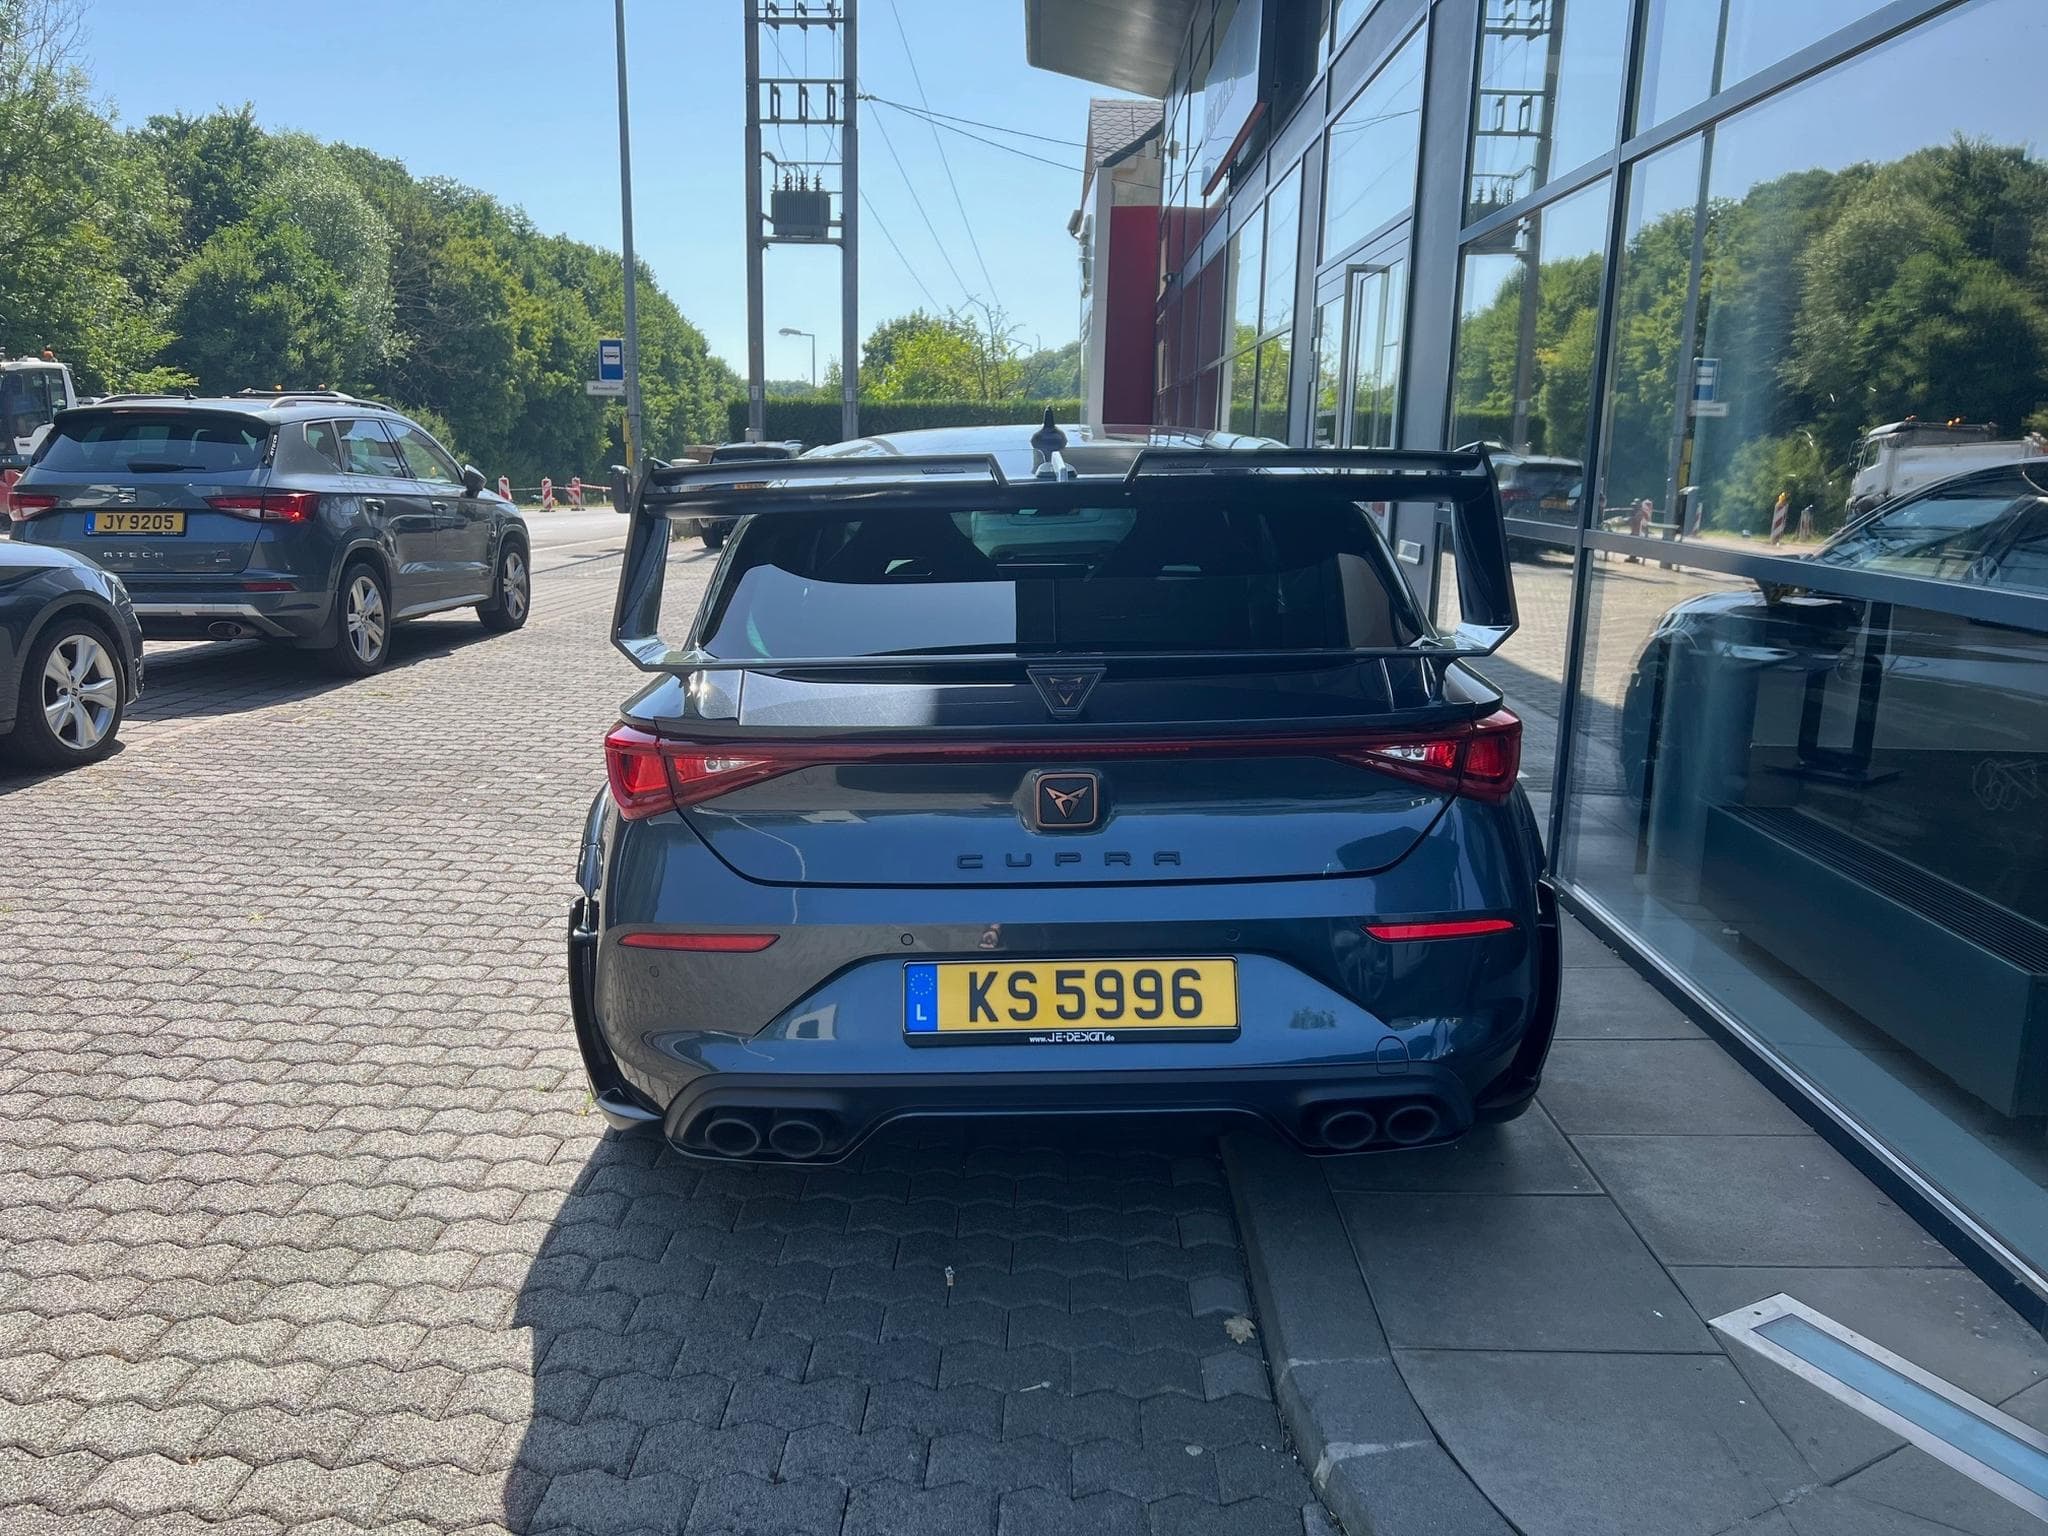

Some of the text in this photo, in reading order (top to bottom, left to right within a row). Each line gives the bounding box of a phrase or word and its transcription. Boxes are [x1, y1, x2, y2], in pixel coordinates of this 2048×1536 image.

[104, 515, 174, 529] JY 9205
[957, 851, 1181, 869] CUPRA
[968, 968, 1203, 1023] KS 5996
[916, 1004, 927, 1021] L
